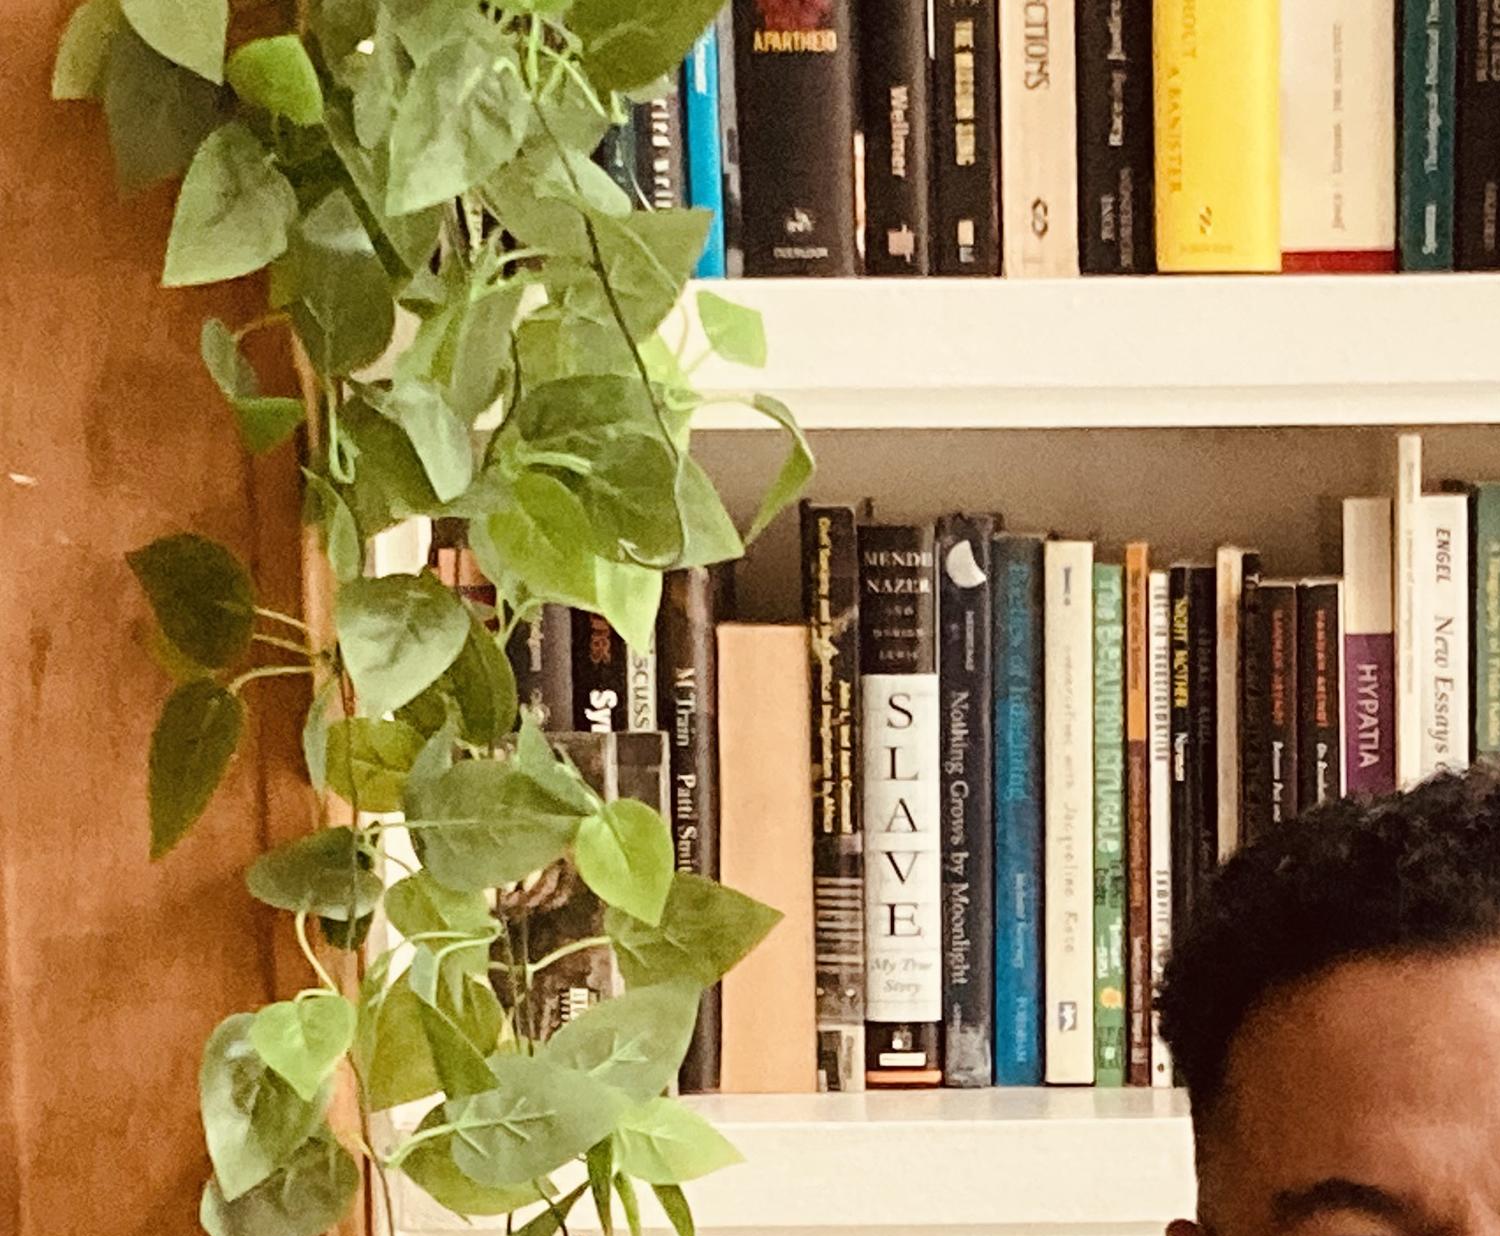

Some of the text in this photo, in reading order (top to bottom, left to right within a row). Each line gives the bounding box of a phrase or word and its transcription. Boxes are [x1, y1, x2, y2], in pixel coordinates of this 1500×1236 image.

[1356, 662, 1380, 767] HYPATIA
[1426, 528, 1457, 755] ENGEL New Essays
[676, 667, 699, 873] M Train Patti Smit
[884, 692, 922, 937] SLAVE
[945, 691, 971, 985] Nothing Grows by Moonlight
[1058, 802, 1079, 954] Jacqueline Rose
